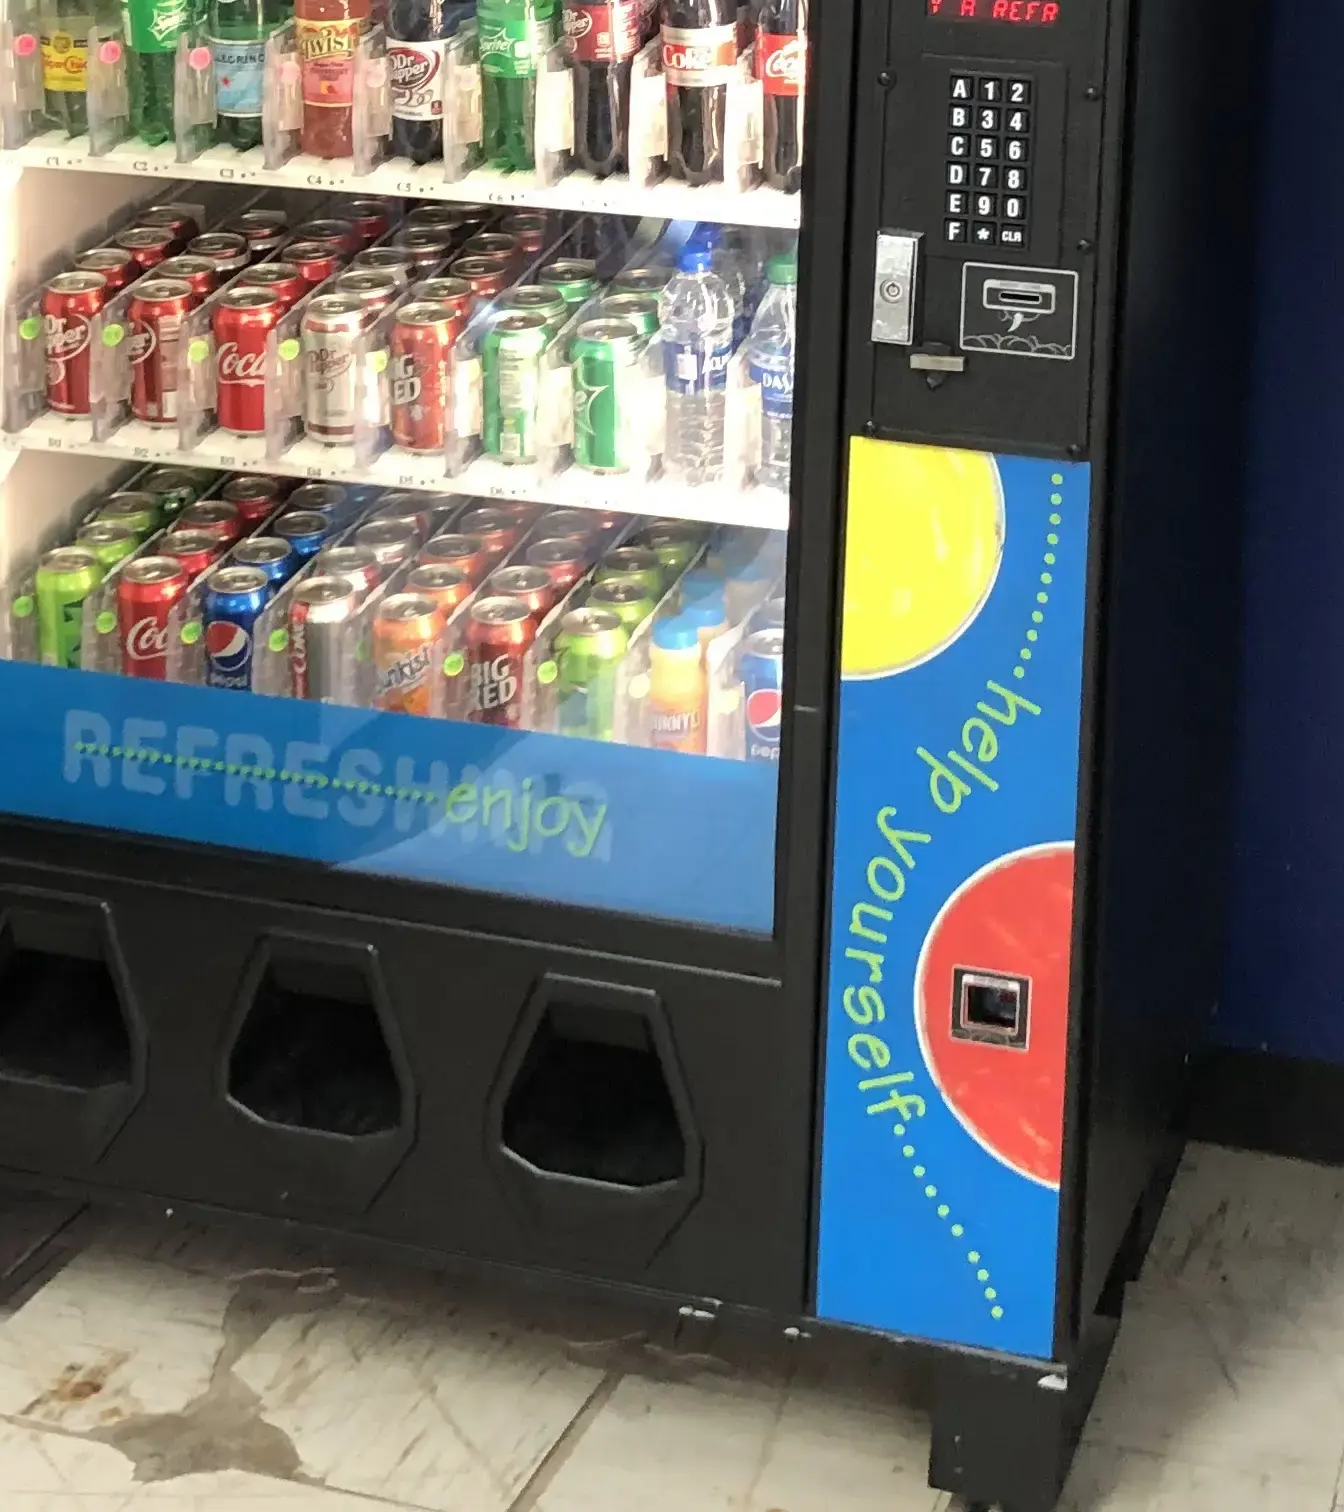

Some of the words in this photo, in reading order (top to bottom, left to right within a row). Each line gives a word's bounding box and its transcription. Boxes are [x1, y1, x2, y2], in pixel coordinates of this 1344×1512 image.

[398, 54, 414, 70] Dr
[953, 80, 967, 98] A
[984, 81, 995, 100] 1
[1011, 83, 1024, 102] 2
[952, 108, 965, 127] B
[981, 110, 993, 129] 3
[1010, 112, 1022, 131] 4
[951, 137, 964, 155] C
[980, 139, 992, 158] 5
[1009, 141, 1021, 160] 6
[133, 161, 148, 172] C2
[306, 175, 322, 186] C4
[950, 165, 963, 184] D
[979, 168, 992, 186] 7
[1008, 170, 1020, 188] 8
[949, 194, 961, 213] E
[978, 196, 990, 215] 9
[1007, 198, 1019, 217] 0
[949, 222, 960, 241] F
[1001, 231, 1022, 243] CLR
[471, 653, 512, 686] BIG
[916, 680, 1043, 814] help
[445, 773, 610, 859] enjoy
[843, 806, 933, 1120] yourself
